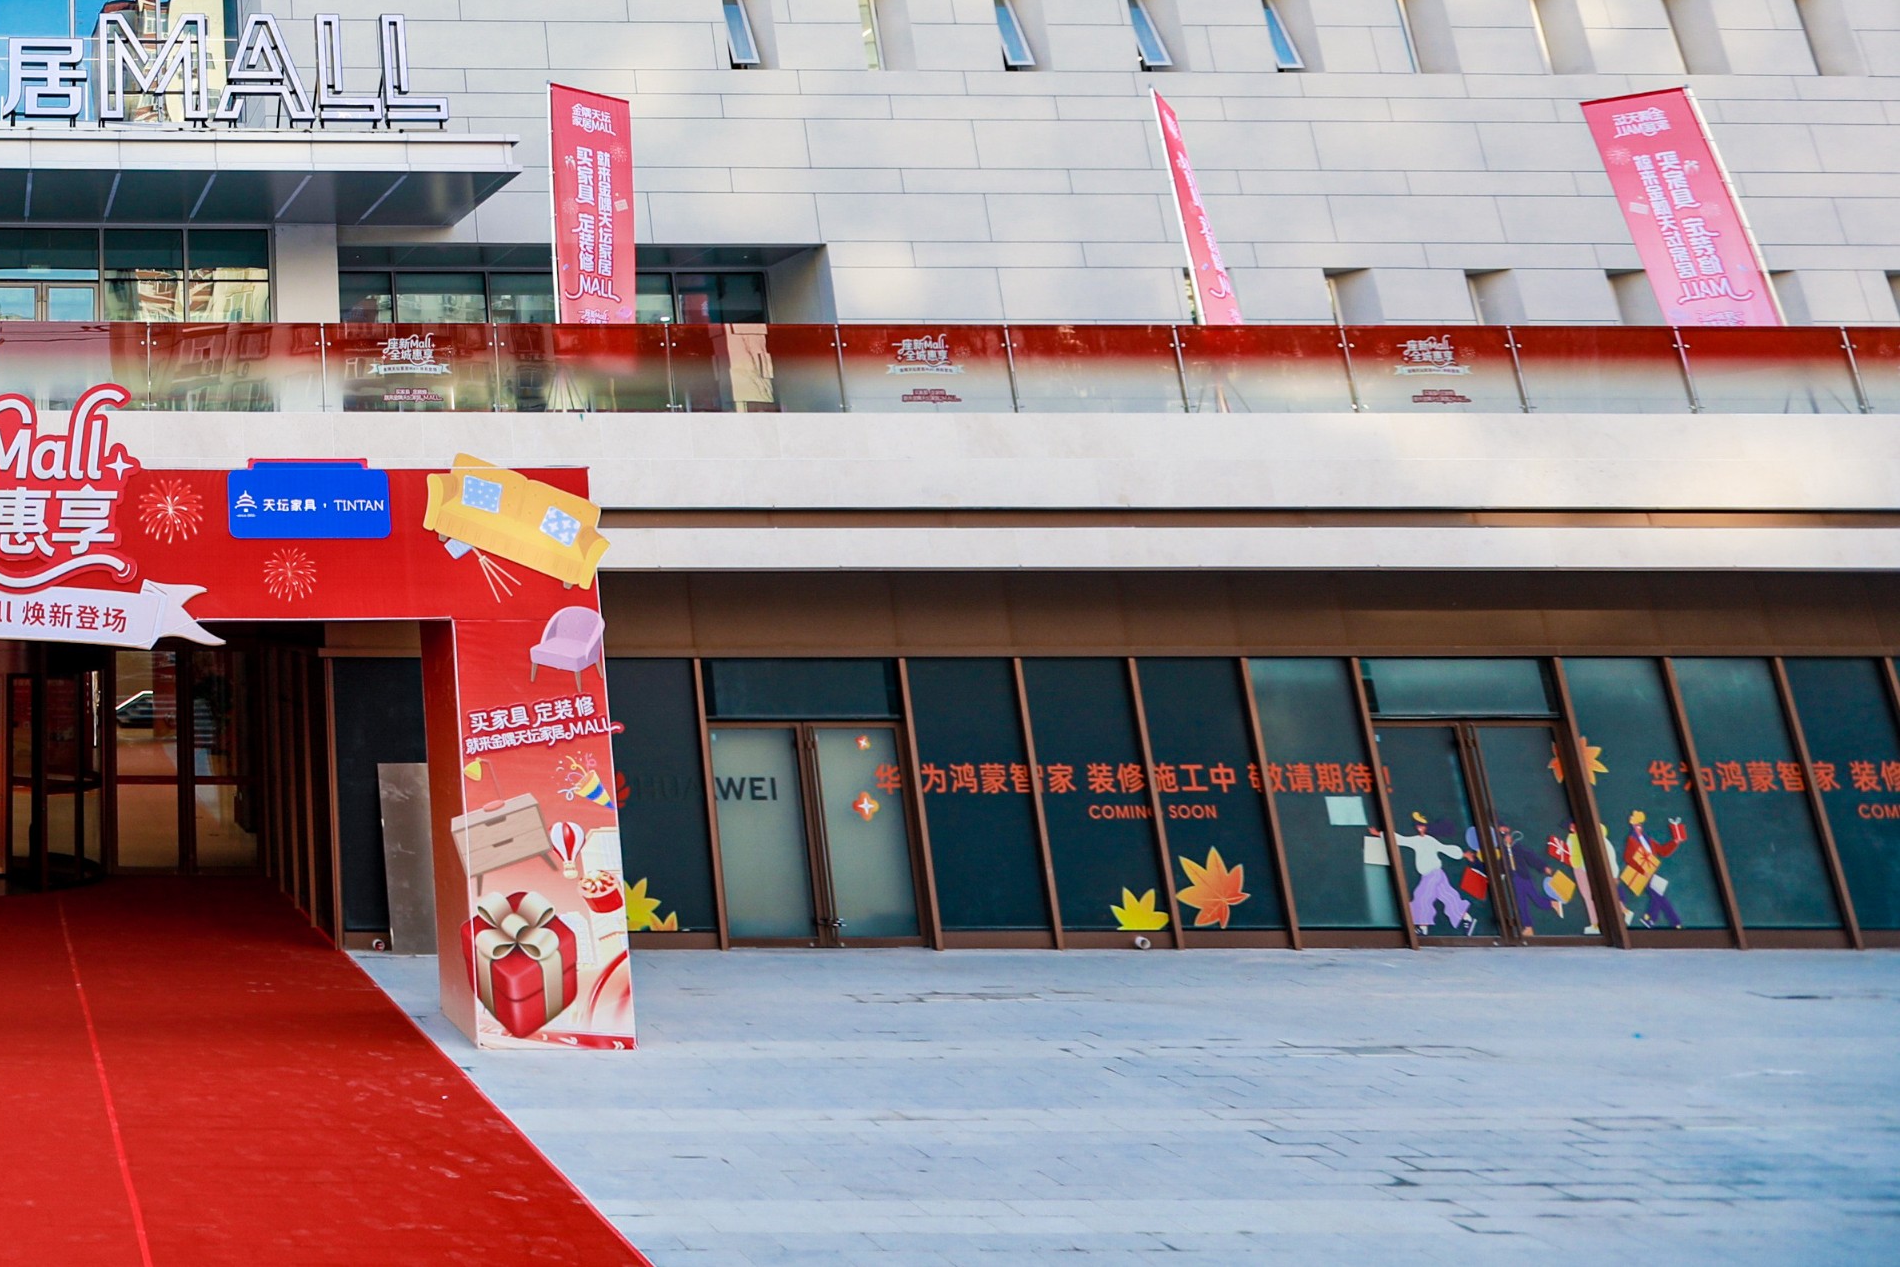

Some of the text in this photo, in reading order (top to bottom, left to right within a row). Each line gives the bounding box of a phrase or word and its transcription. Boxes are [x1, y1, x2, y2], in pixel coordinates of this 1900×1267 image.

[571, 103, 612, 123] 金隅天坛
[572, 116, 616, 136] 家居MALL
[572, 146, 595, 272] 买家具 定装修
[597, 150, 613, 276] 就来金隅天坛家居
[564, 273, 621, 302] MALL
[376, 332, 434, 352] 一座新Mall
[386, 348, 436, 365] 全城惠享
[263, 498, 385, 512] 天坛家具 TINTAN
[21, 600, 128, 634] 焕新登场
[469, 695, 595, 734] 买家具 定装修
[465, 718, 621, 756] 就来金隅天坛家居MALL
[874, 762, 1077, 795] 华为鸿蒙智家
[1086, 761, 1236, 794] 装修施工中
[1168, 804, 1217, 819] SOON
